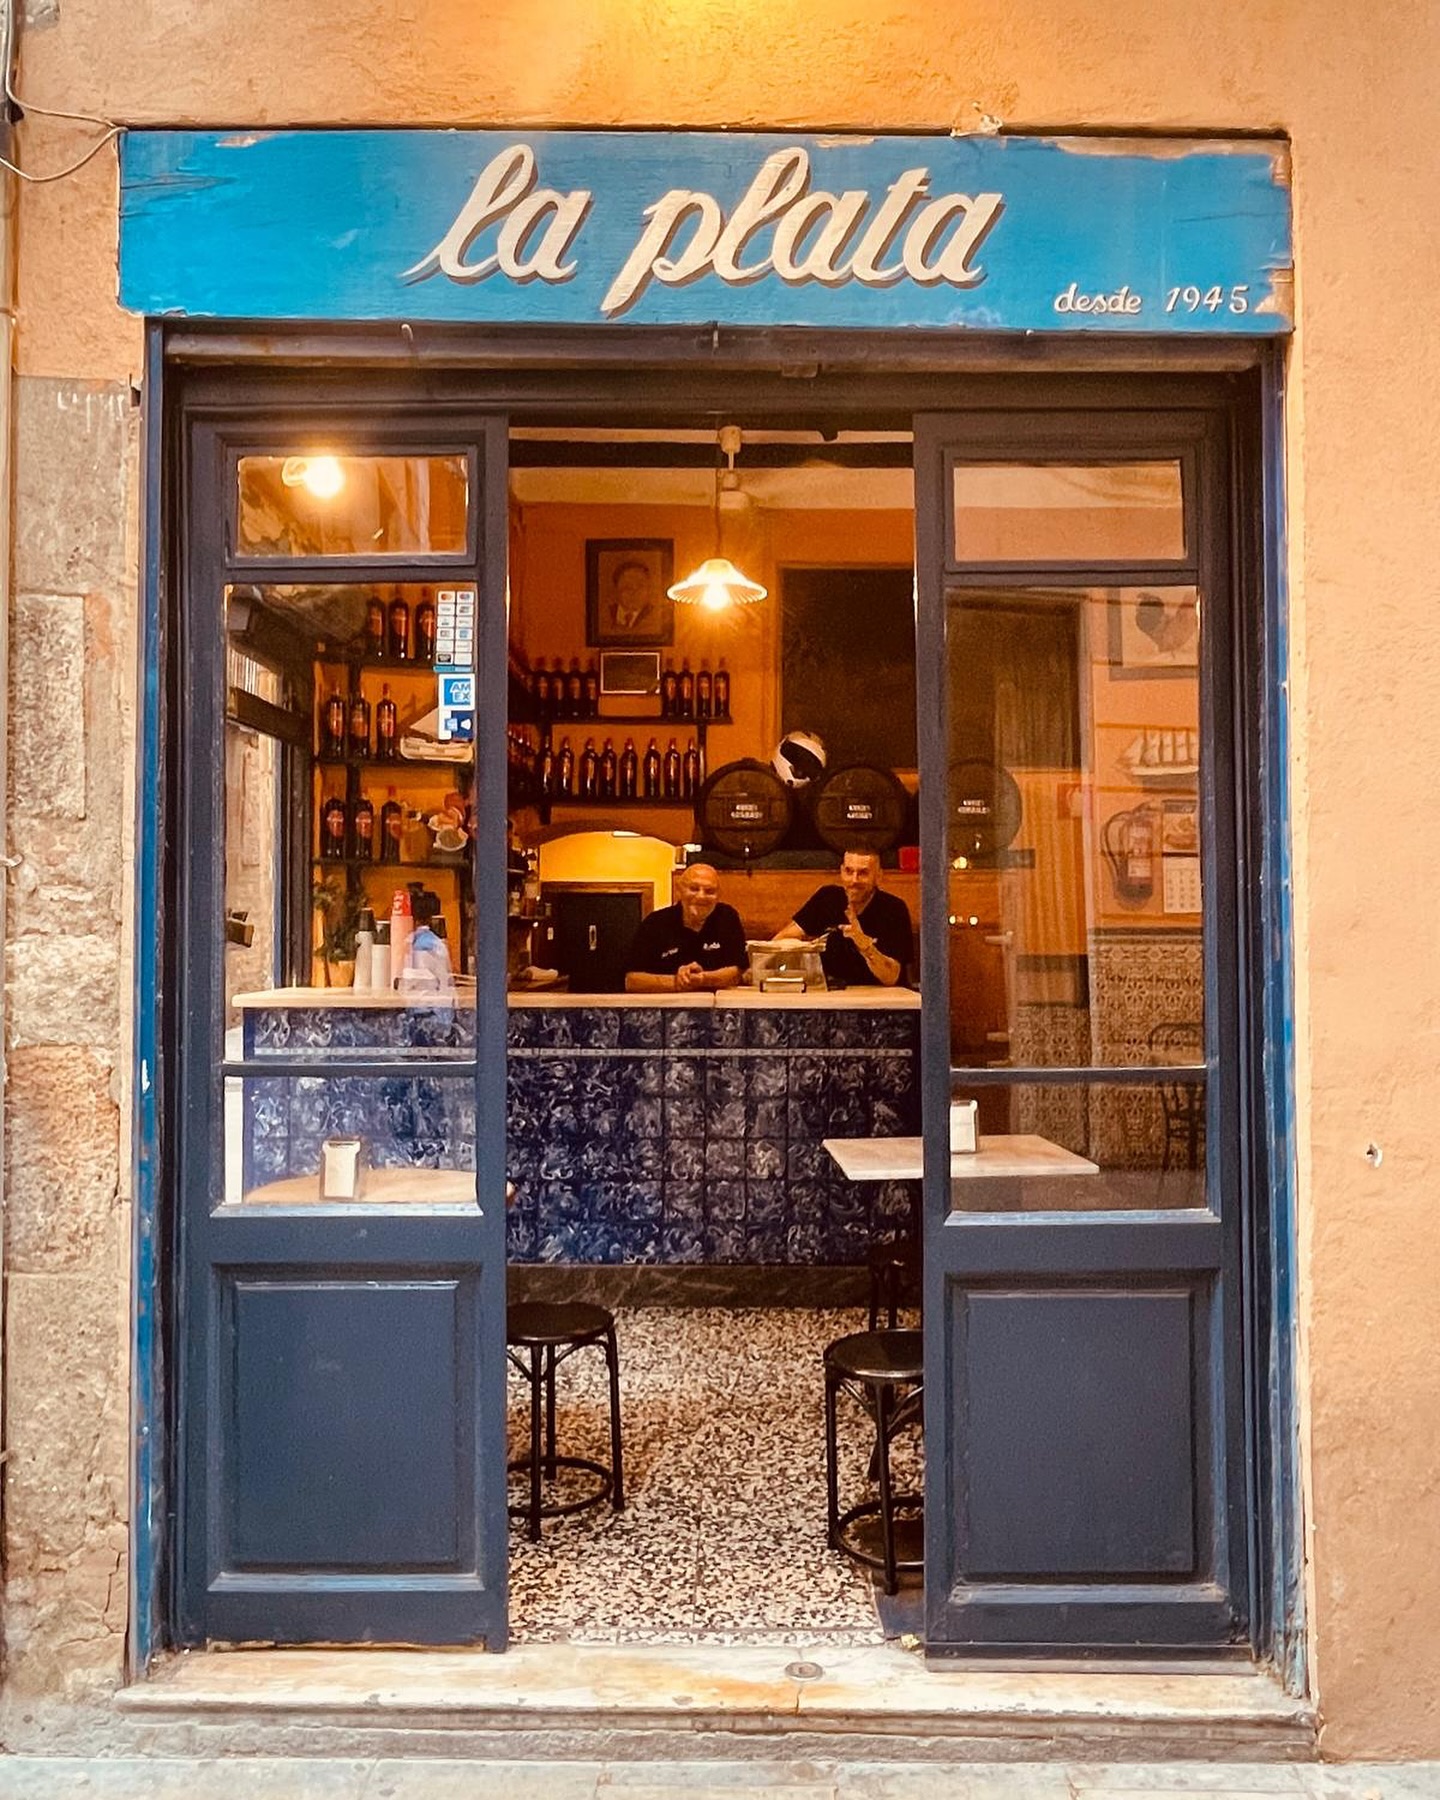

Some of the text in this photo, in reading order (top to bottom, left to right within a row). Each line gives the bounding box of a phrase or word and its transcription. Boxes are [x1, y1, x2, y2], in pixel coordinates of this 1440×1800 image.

[400, 143, 1005, 314] la plata
[1054, 282, 1249, 315] desde 1945
